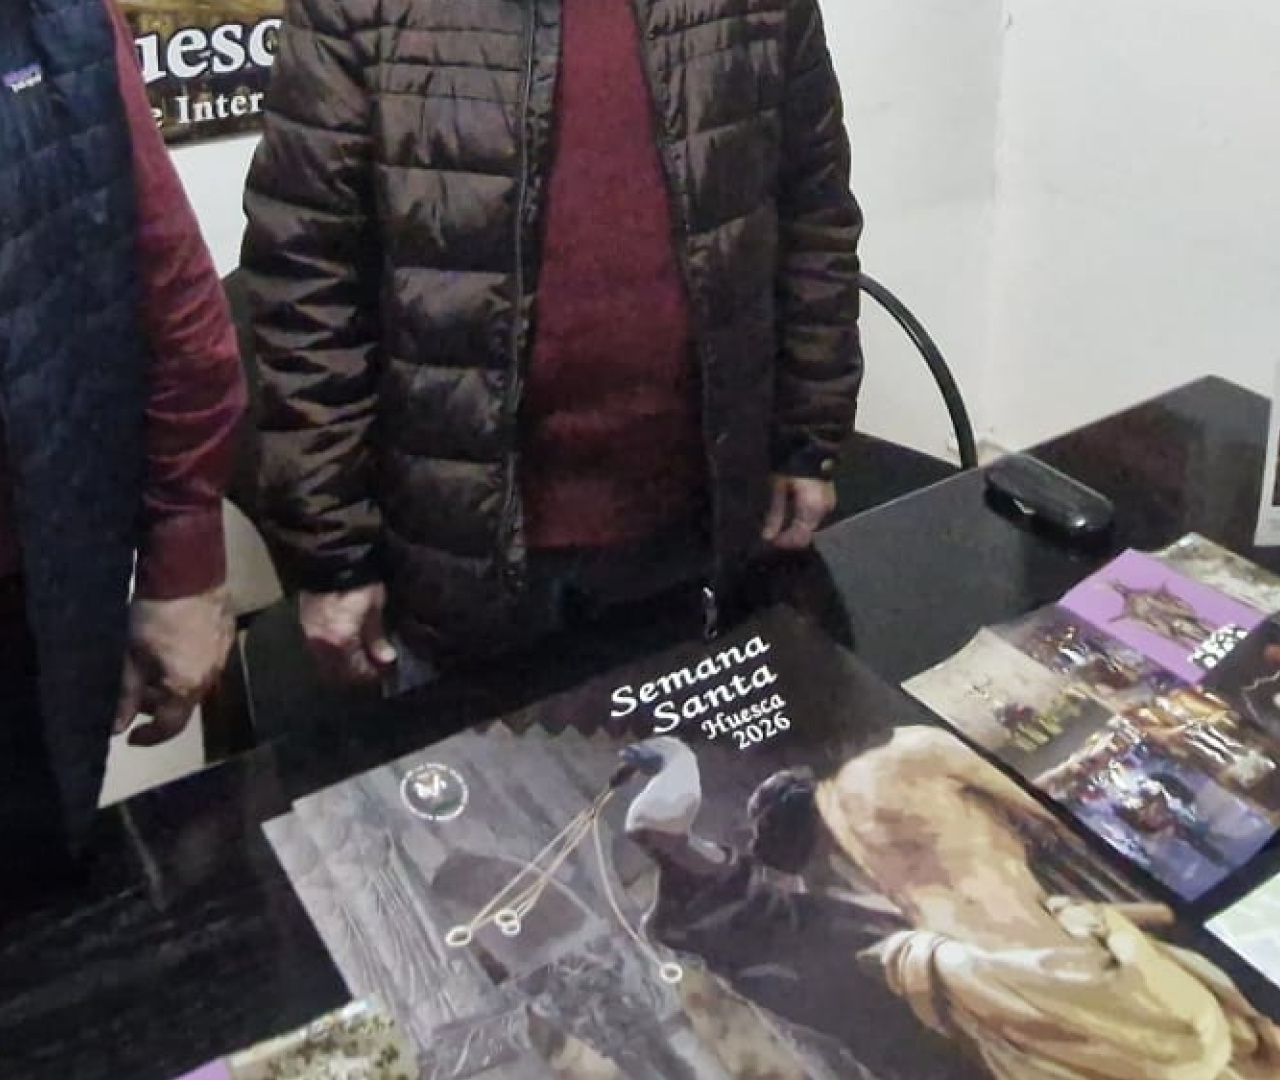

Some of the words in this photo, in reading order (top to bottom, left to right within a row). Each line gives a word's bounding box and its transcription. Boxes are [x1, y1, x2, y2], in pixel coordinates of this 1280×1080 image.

[174, 91, 265, 124] Inter
[611, 635, 769, 717] Semana
[653, 664, 778, 734] Santa
[701, 693, 786, 739] Huesca
[732, 712, 792, 750] 2026
